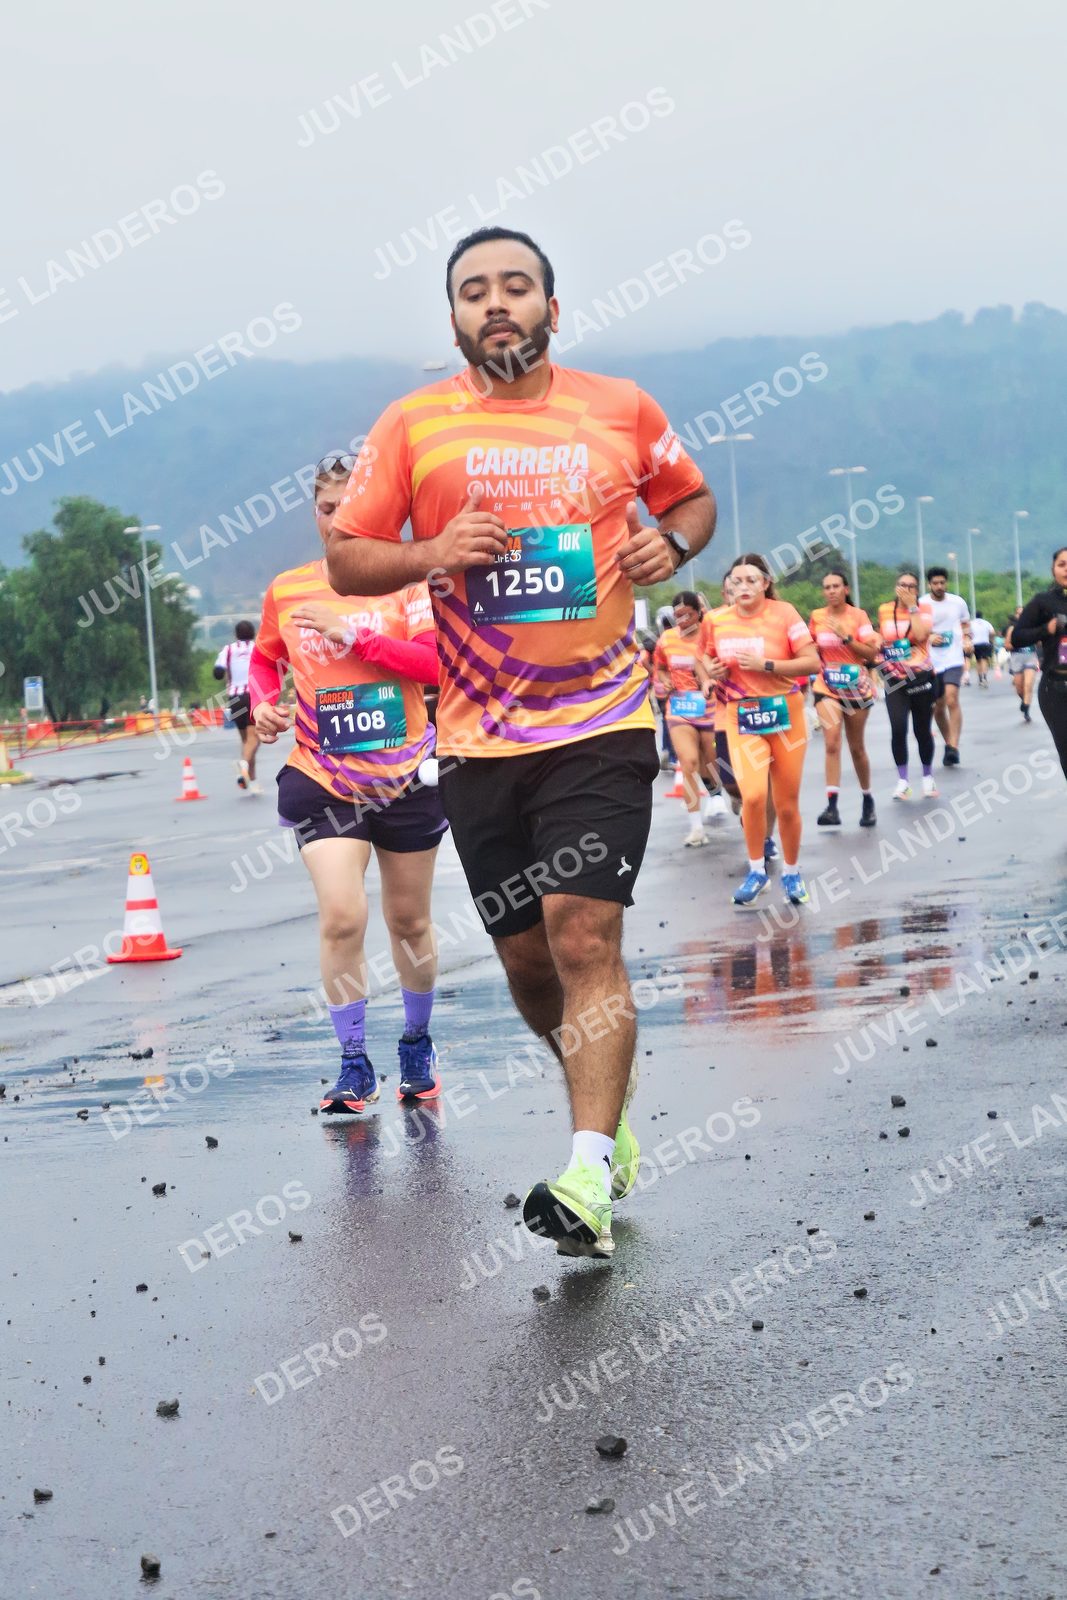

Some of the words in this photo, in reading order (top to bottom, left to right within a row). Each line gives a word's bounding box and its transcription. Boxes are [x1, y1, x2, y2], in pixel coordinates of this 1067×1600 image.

[466, 443, 589, 476] CARRERA
[467, 477, 561, 498] OMNILIFE
[558, 532, 581, 552] 10K
[485, 566, 564, 597] 1250
[319, 691, 354, 705] CARRERA
[378, 686, 395, 700] 10K
[330, 710, 386, 735] 1108
[747, 710, 777, 725] 1567
